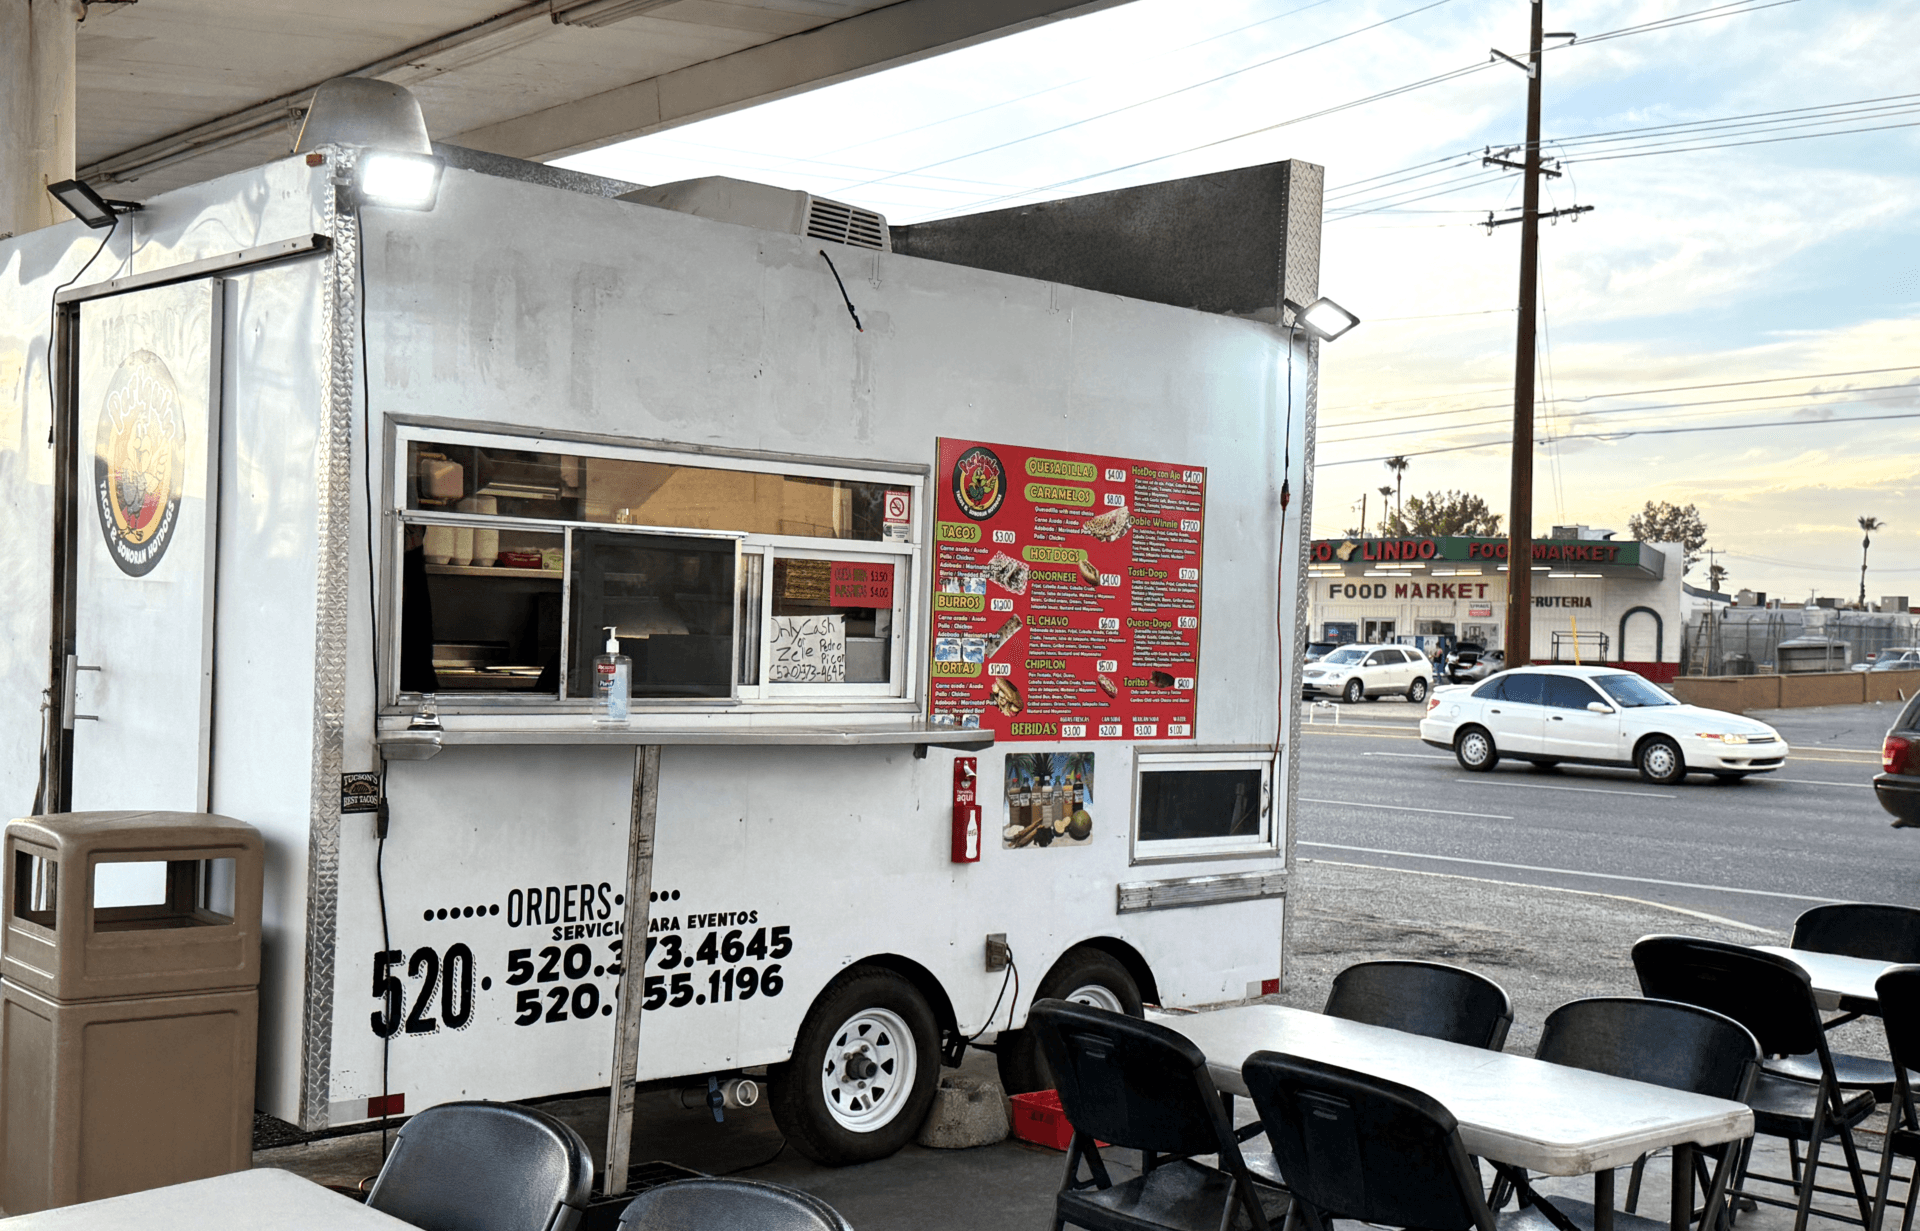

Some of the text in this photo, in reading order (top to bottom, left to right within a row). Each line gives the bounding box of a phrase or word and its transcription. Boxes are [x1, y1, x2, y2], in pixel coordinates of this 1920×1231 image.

[1029, 459, 1094, 478] QUESADILLAS
[1157, 471, 1169, 479] con
[1030, 485, 1090, 503] CARAMELOS
[100, 480, 113, 529] TACOS
[110, 526, 117, 545] &
[117, 540, 147, 565] SONORAN
[941, 525, 976, 539] TACOS
[995, 531, 1014, 543] $3.00
[1030, 547, 1080, 562] HOT DOGS
[1362, 540, 1436, 561] LINDO
[1469, 542, 1621, 562] FOO MARKET
[1329, 583, 1489, 599] FOOD MARKET
[938, 595, 980, 609] BURROS
[802, 616, 836, 636] Cash
[1026, 615, 1069, 627] EL CHAVO
[819, 638, 842, 652] Pedro
[936, 661, 975, 674] TORTAS
[1025, 659, 1066, 670] CHIPILON
[1123, 677, 1148, 687] Toritos
[1011, 722, 1058, 736] BEBIDAS
[1064, 726, 1081, 736] $3.00
[1135, 725, 1152, 735] $3.00
[343, 795, 378, 807] BEST TACOS
[507, 881, 613, 929] ORDERS
[647, 917, 681, 933] ARA
[687, 910, 759, 931] EVENTOS
[514, 964, 784, 1027] 520.55.1196
